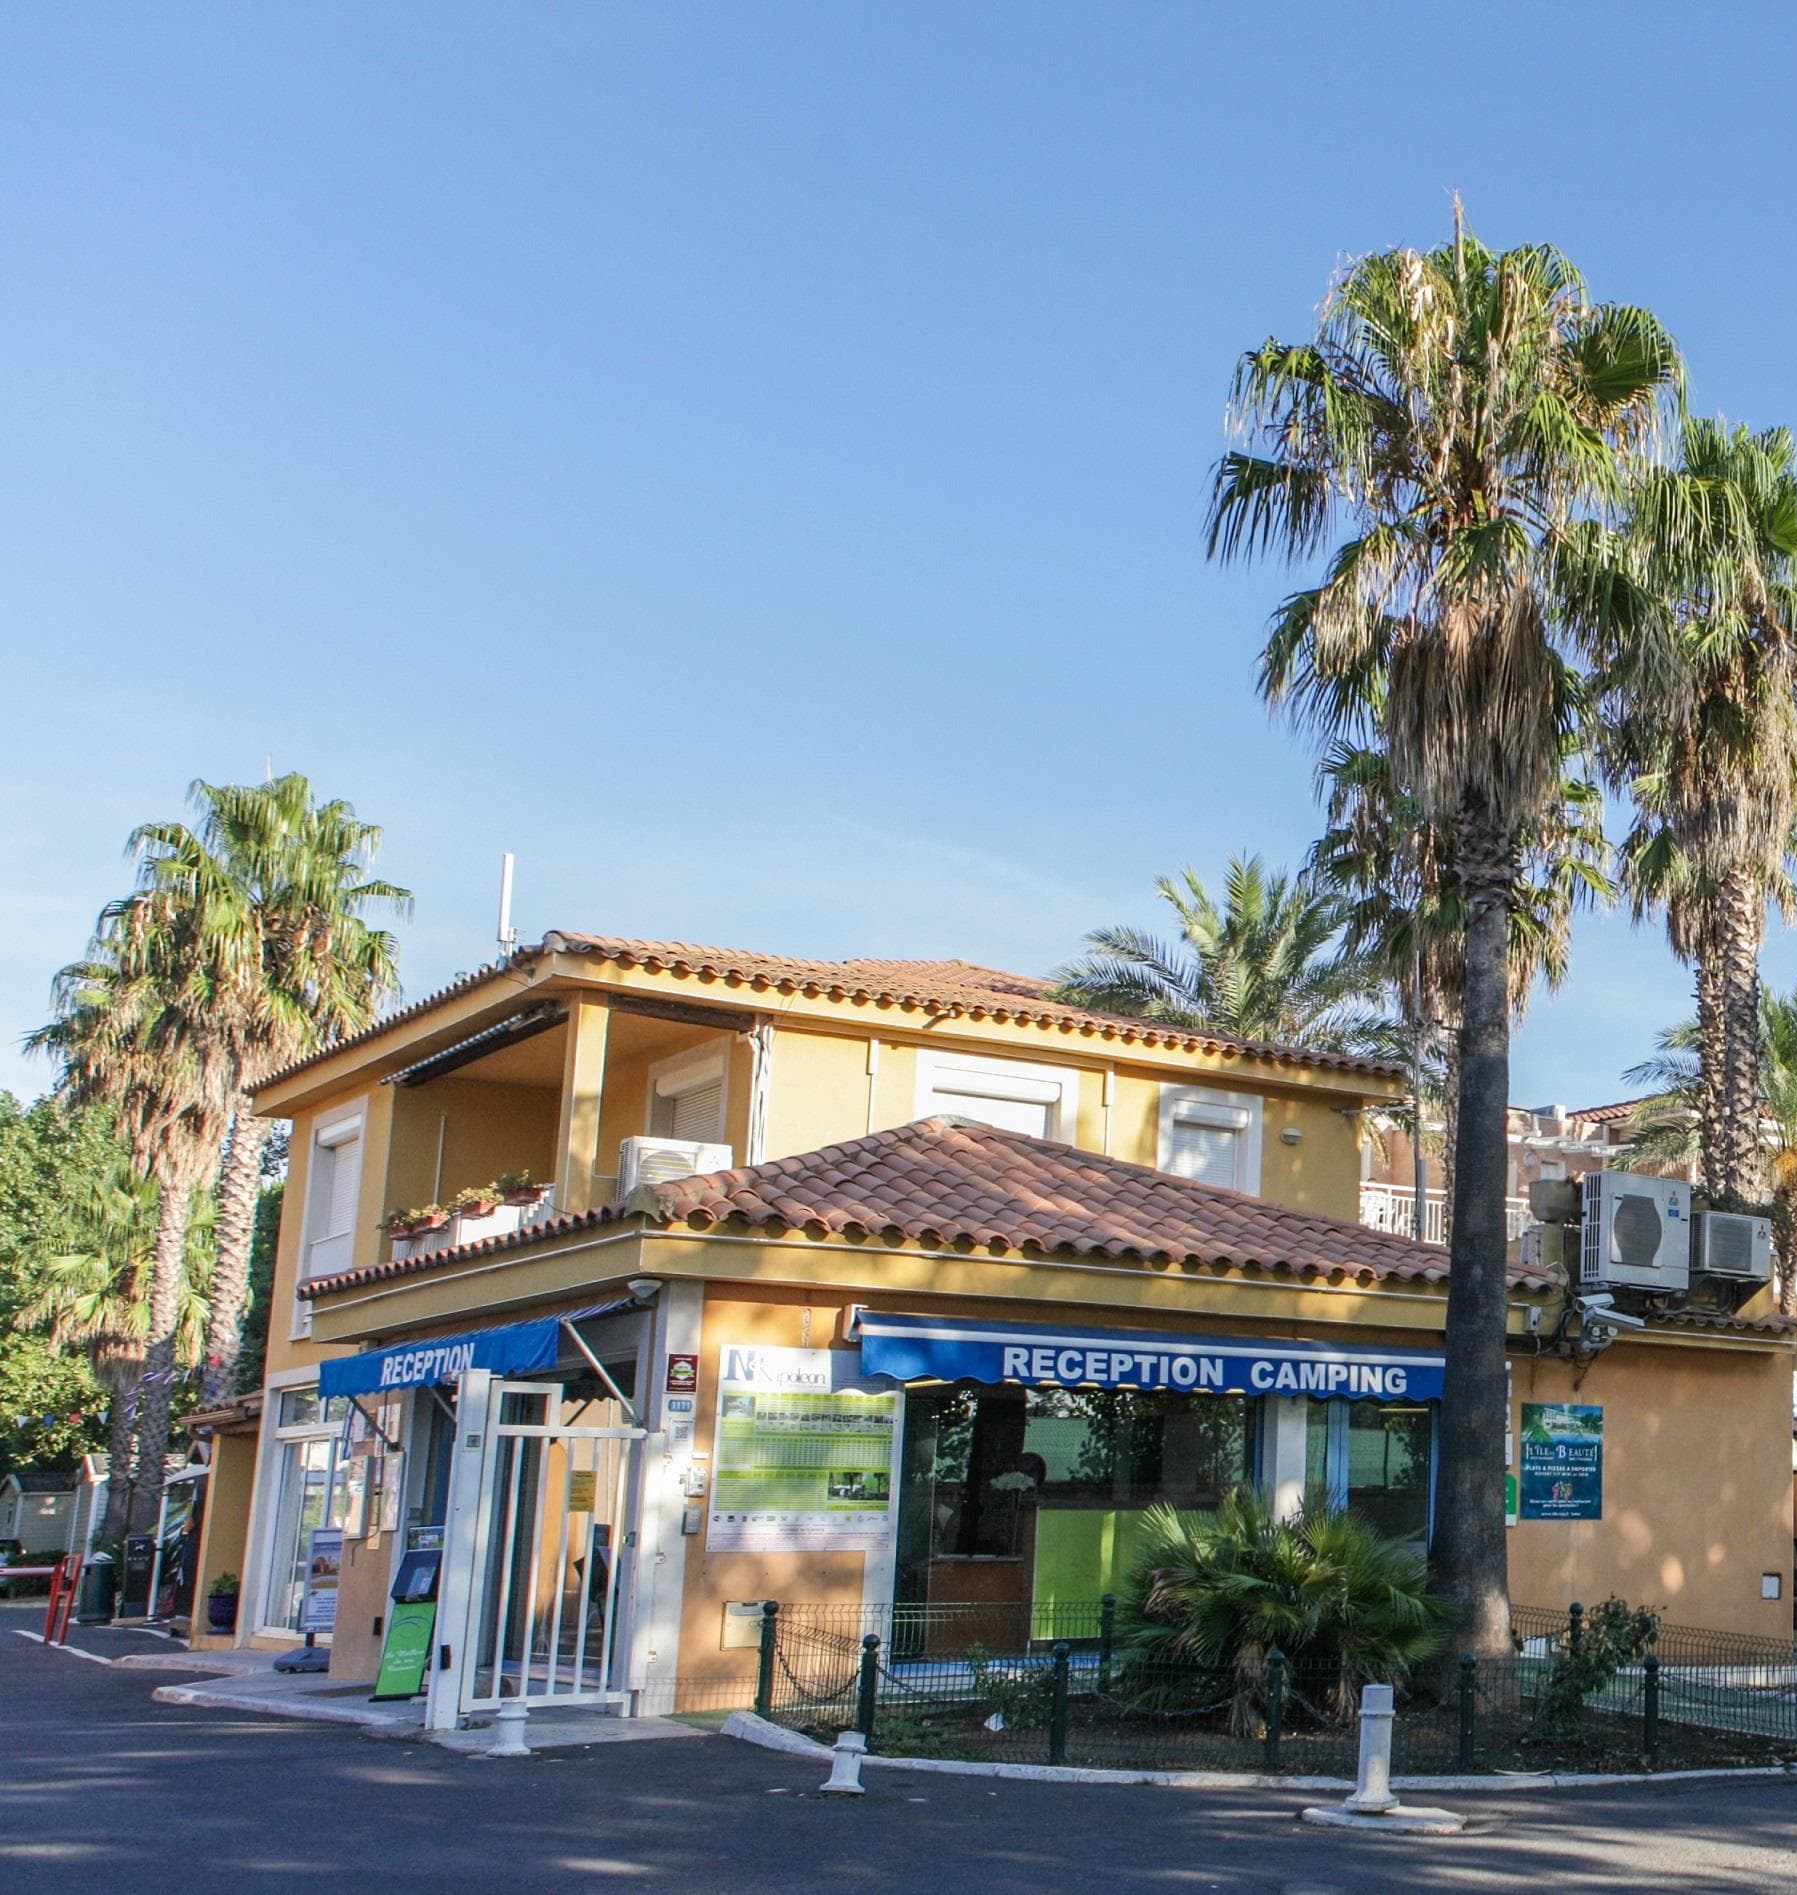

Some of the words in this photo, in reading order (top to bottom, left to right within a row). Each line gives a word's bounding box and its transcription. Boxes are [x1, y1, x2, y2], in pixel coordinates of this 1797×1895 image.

[380, 1342, 475, 1386] RECEPTION
[1003, 1347, 1224, 1386] RECEPTION
[1250, 1360, 1408, 1394] CAMPING
